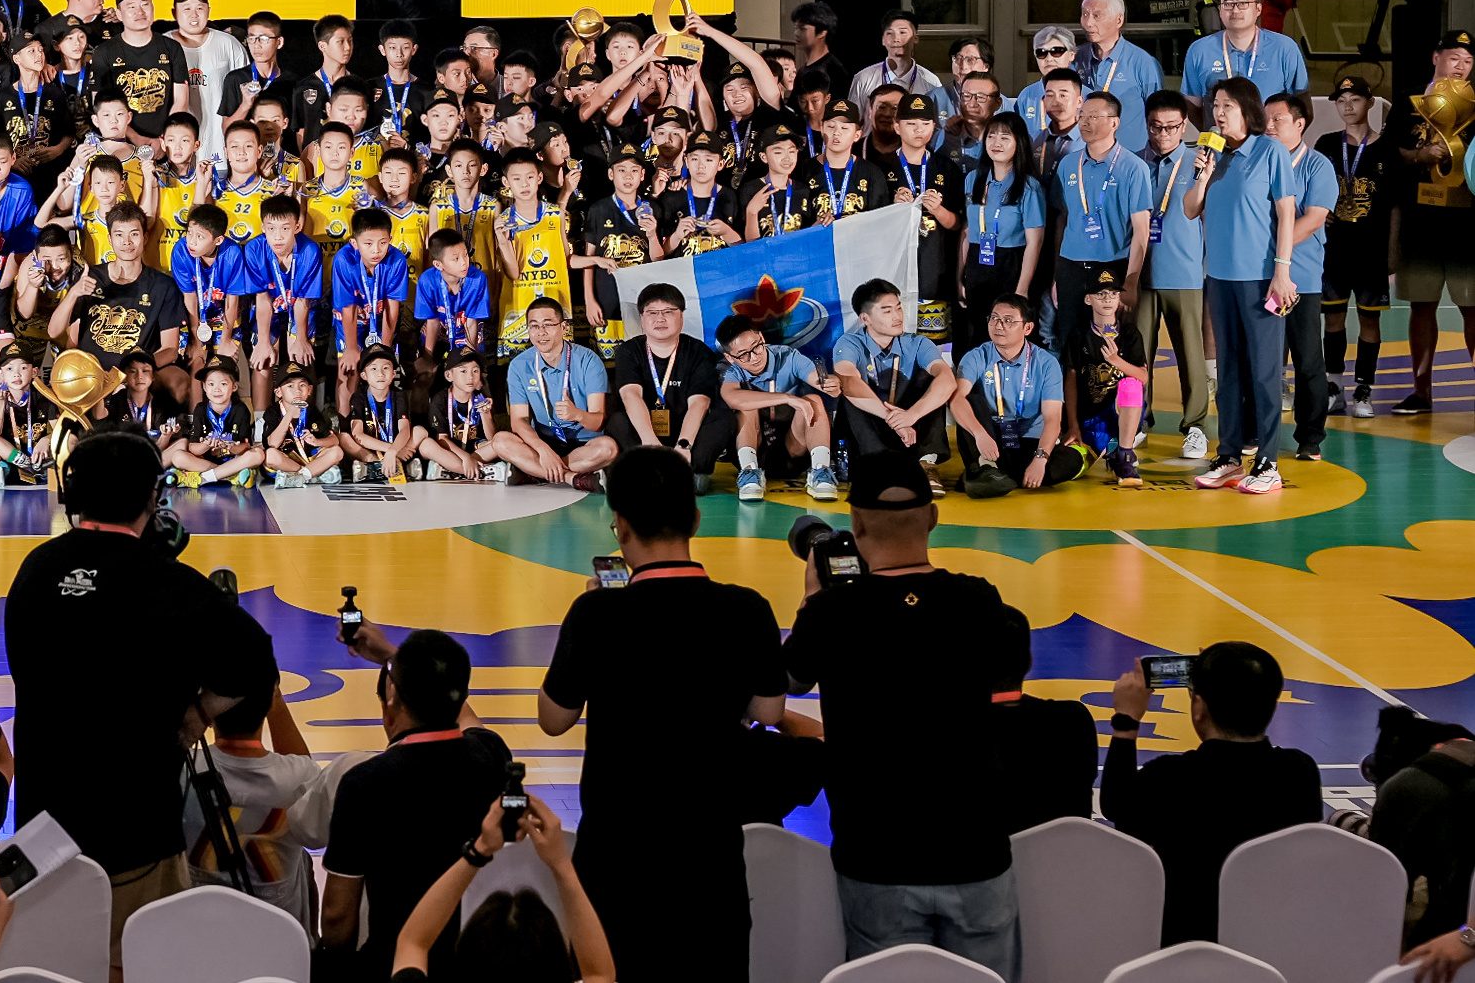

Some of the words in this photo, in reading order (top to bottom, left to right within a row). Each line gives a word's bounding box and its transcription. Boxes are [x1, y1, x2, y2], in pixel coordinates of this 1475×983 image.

[234, 203, 252, 215] 32
[330, 206, 343, 214] 31
[531, 232, 541, 242] 11
[521, 269, 557, 282] NYBO
